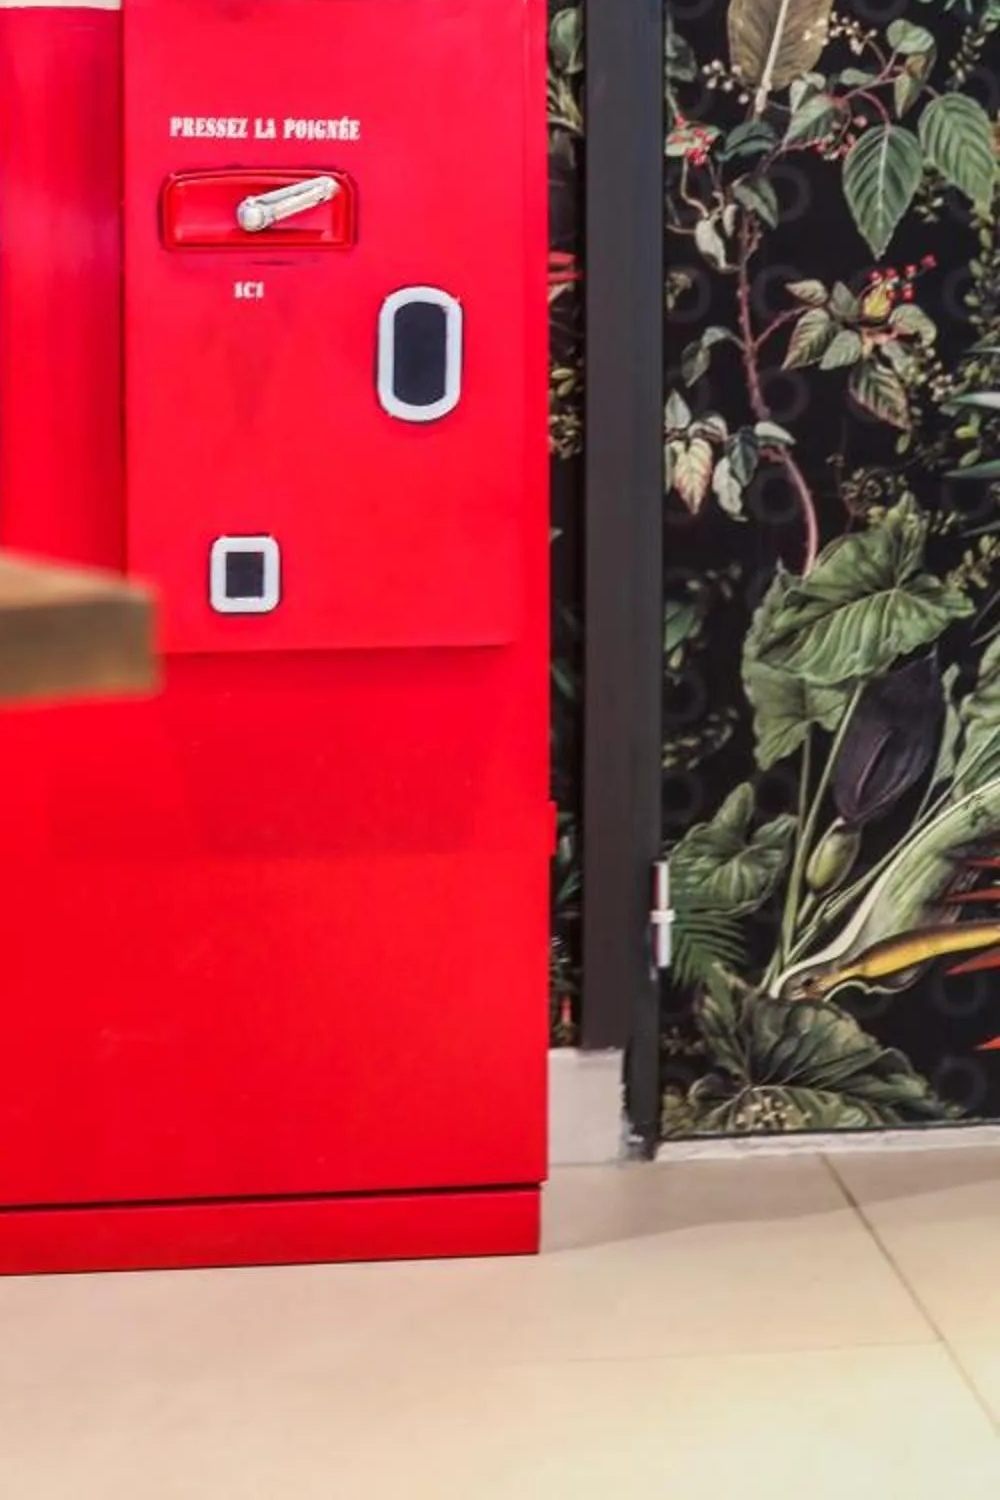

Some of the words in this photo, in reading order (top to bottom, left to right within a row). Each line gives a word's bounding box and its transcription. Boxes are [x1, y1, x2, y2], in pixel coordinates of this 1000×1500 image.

[169, 116, 248, 138] PRESSEZ
[255, 118, 277, 139] LA
[283, 116, 361, 141] POIGNÉE
[234, 281, 265, 299] ICI
